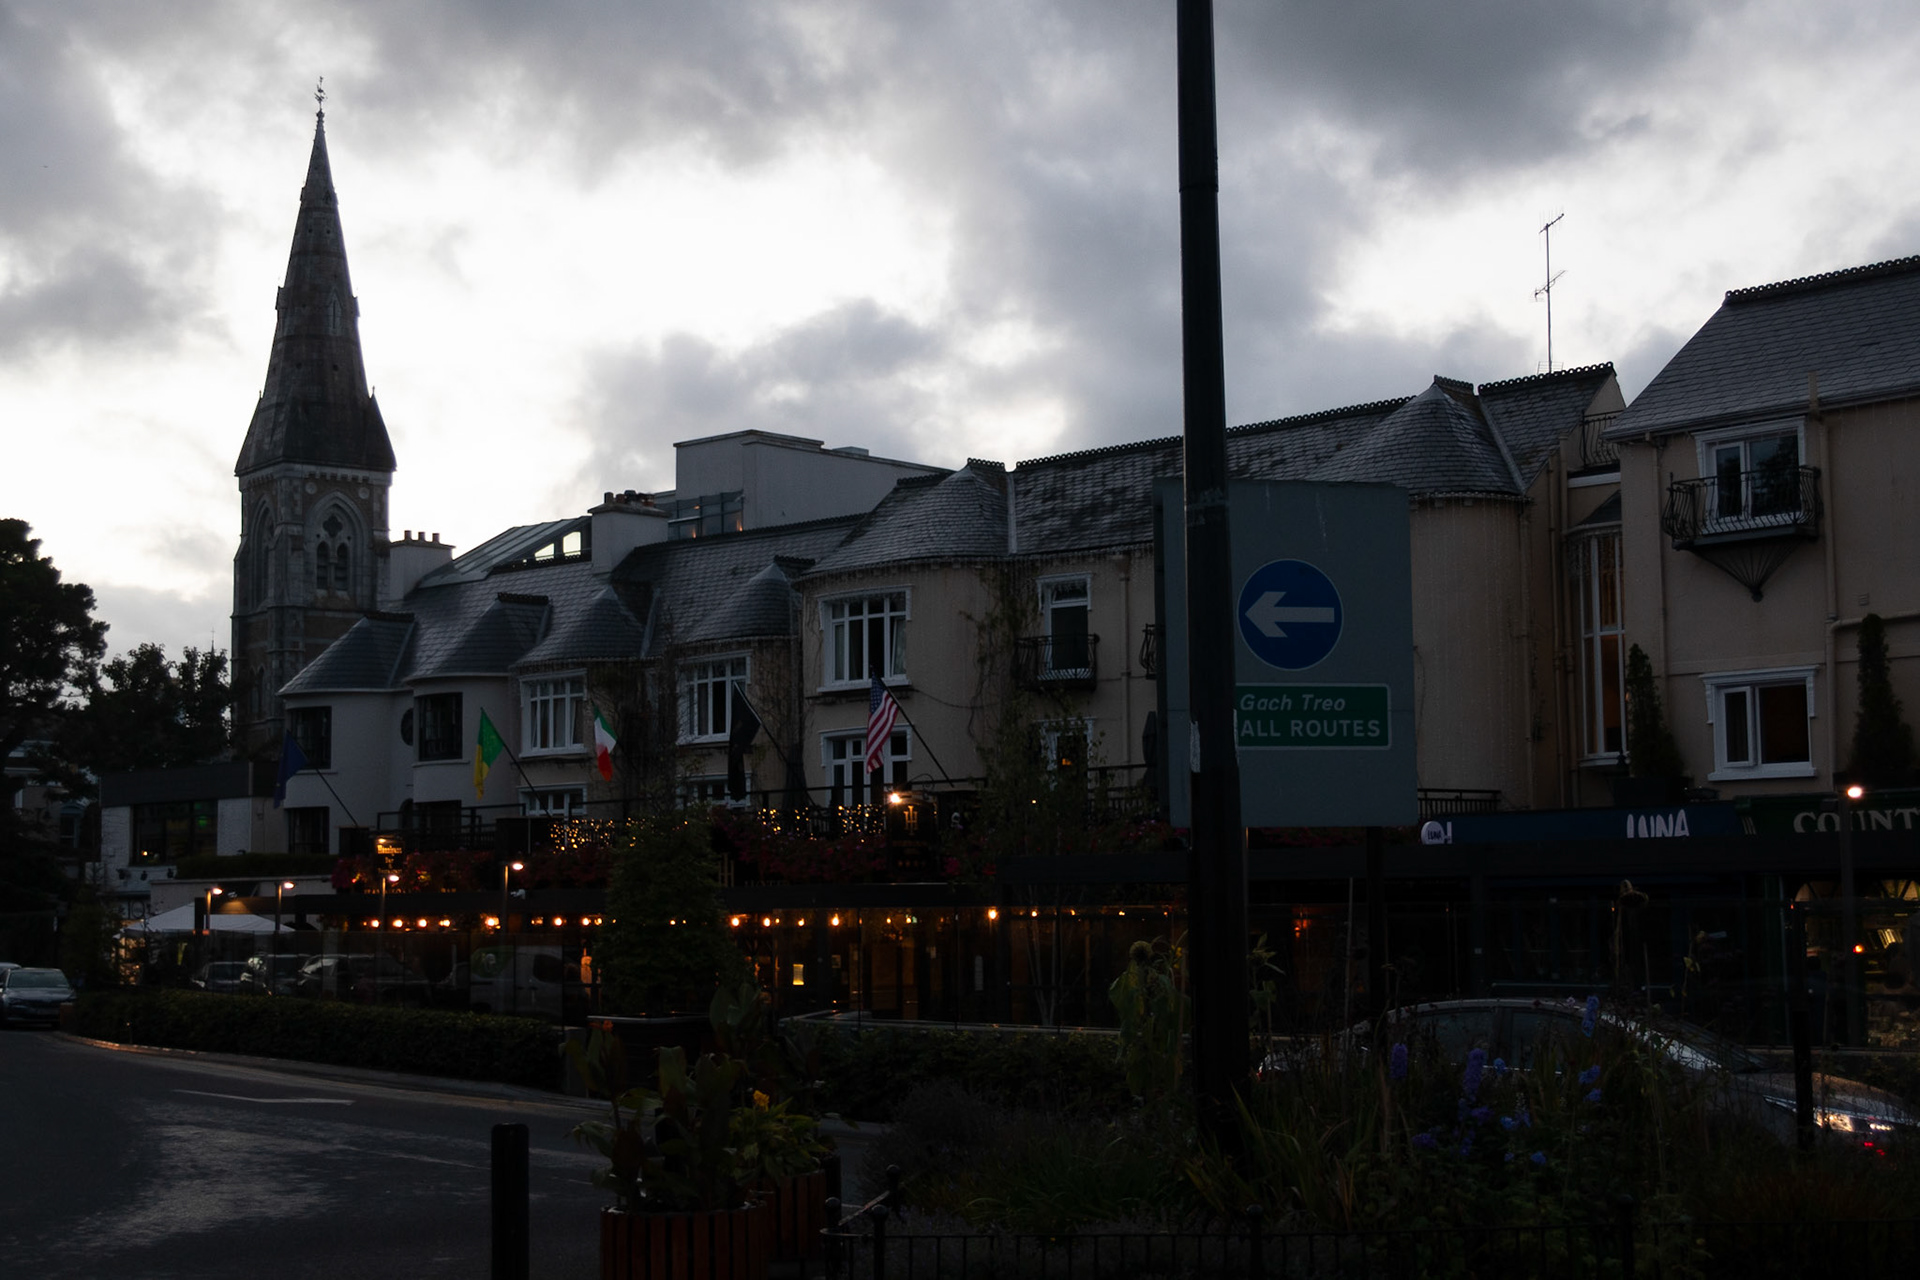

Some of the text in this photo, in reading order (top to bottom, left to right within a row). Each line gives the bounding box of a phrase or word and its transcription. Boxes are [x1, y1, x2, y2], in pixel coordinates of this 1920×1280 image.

[1239, 693, 1347, 712] Gach Treo
[1240, 719, 1381, 738] ALL ROUTES
